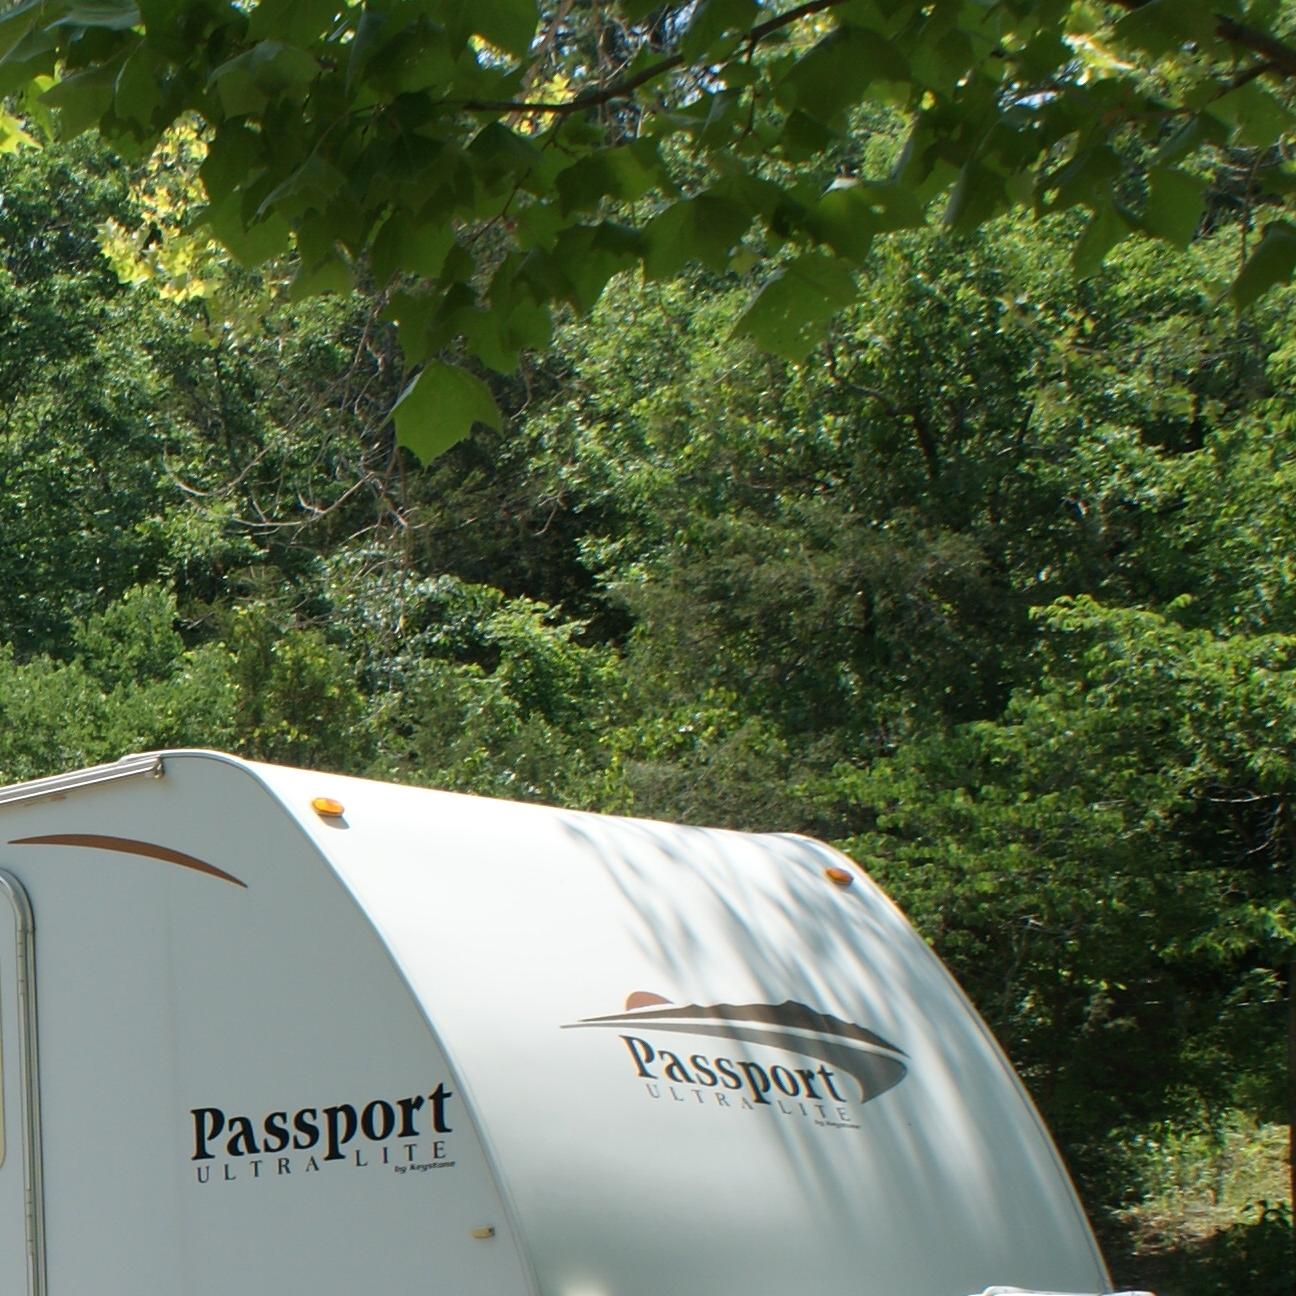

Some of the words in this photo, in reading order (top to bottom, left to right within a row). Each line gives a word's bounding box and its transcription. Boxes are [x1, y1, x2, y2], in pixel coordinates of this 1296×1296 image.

[619, 1035, 847, 1105] Passport
[191, 1082, 453, 1161] Passport
[197, 1155, 320, 1184] ULTRA
[355, 1140, 446, 1167] LITE
